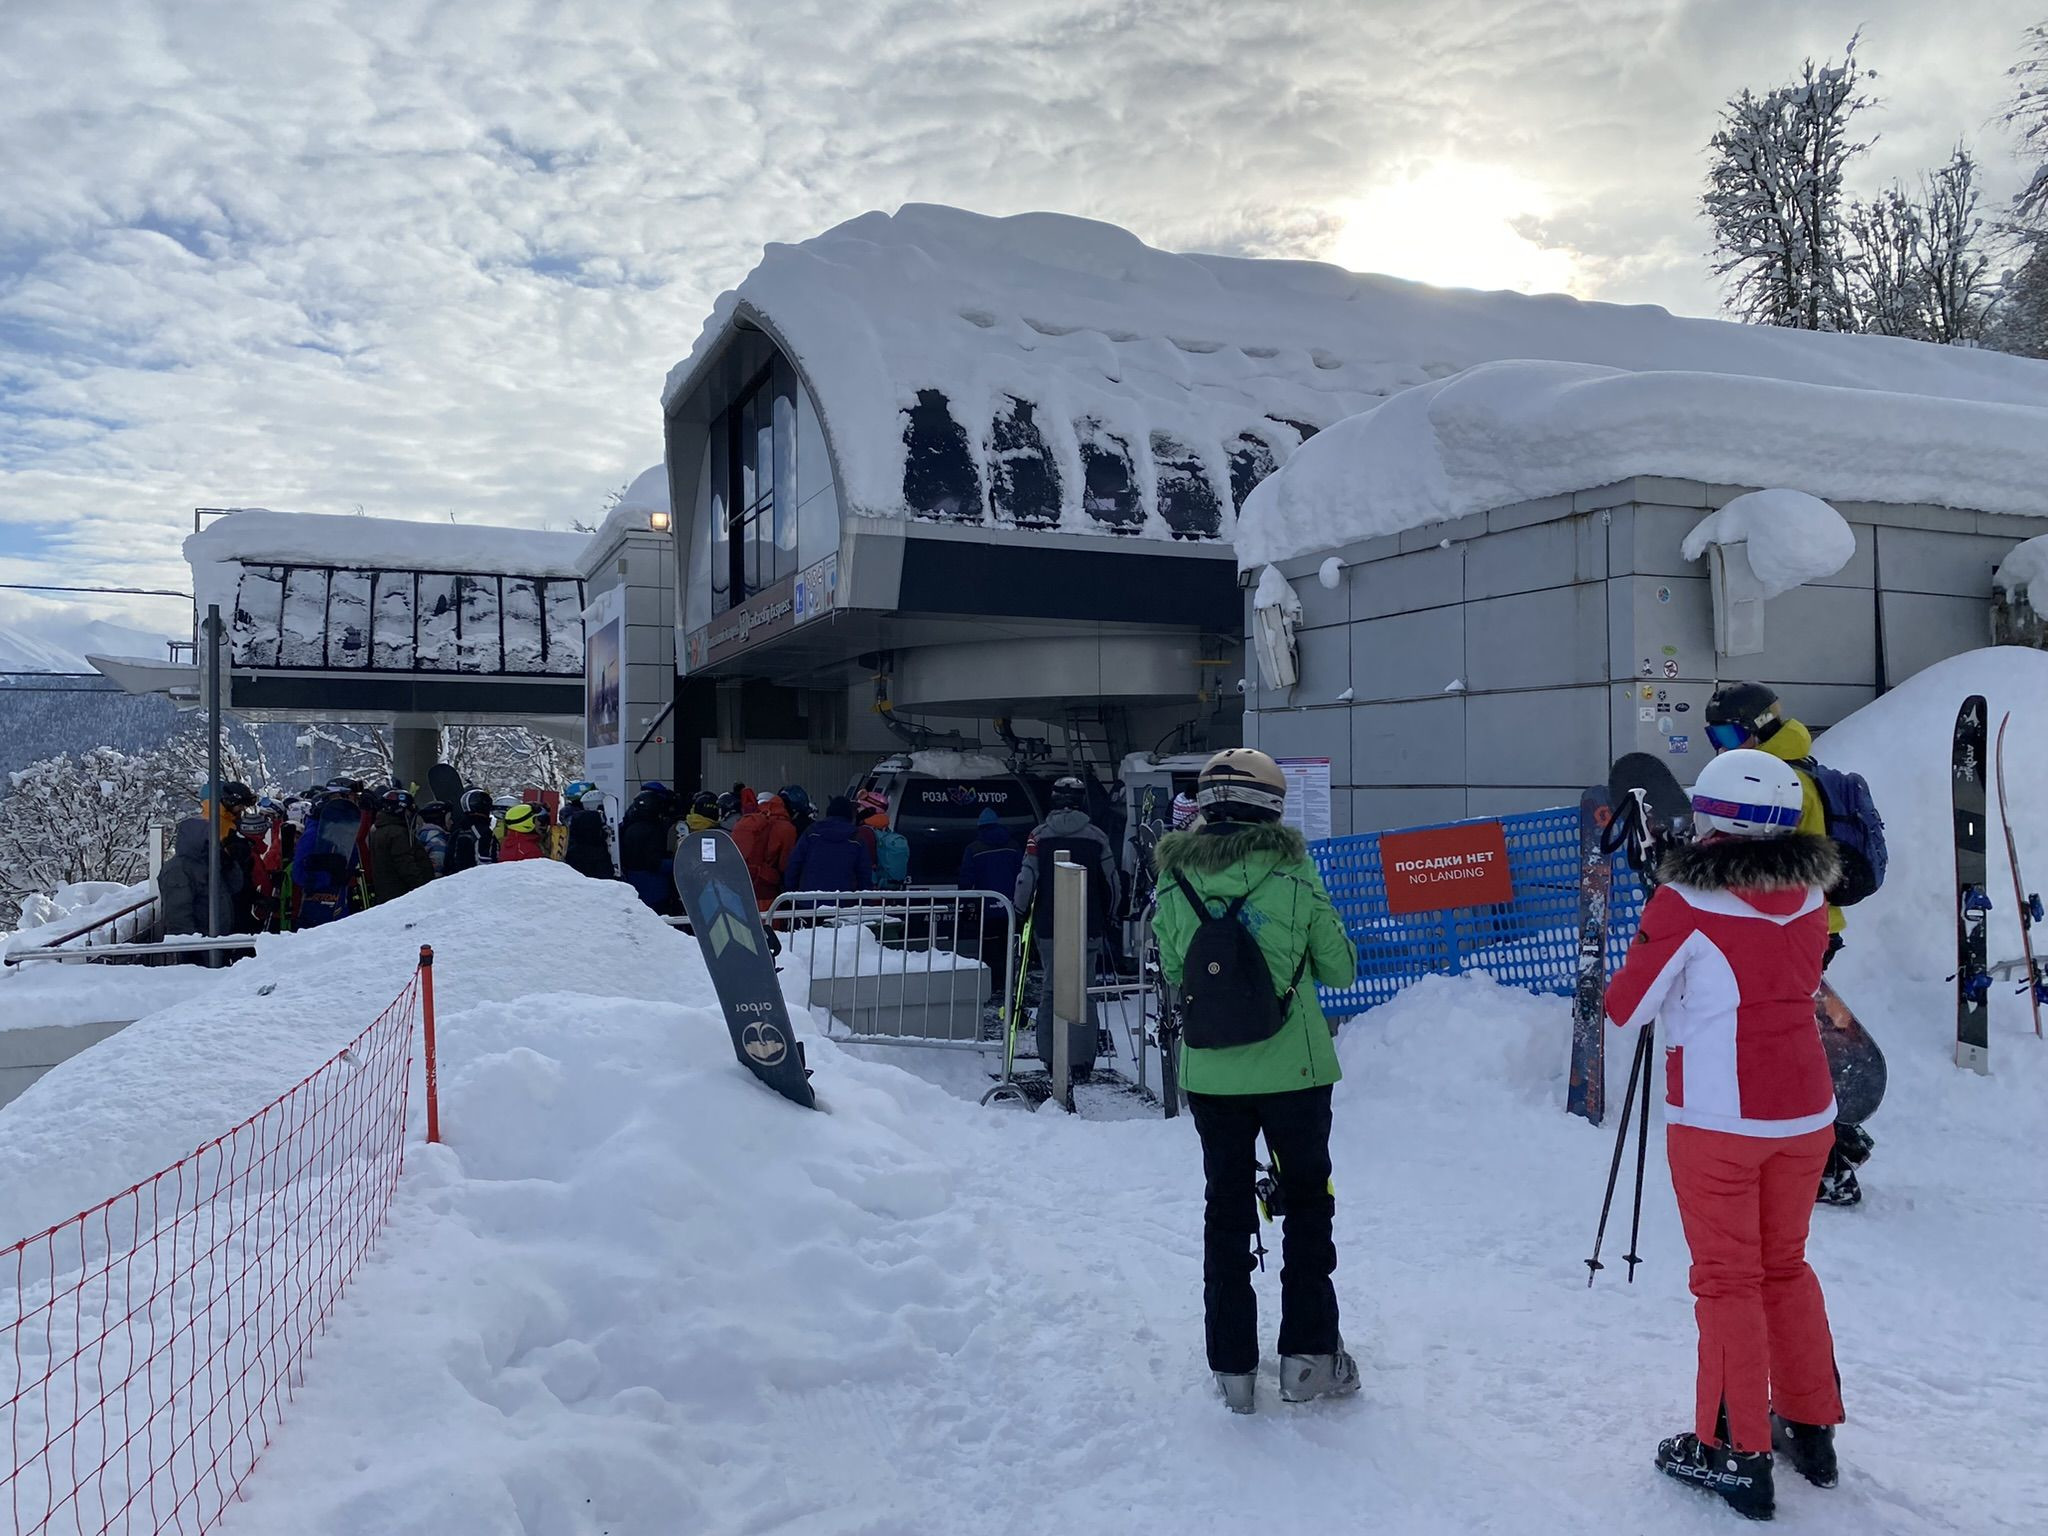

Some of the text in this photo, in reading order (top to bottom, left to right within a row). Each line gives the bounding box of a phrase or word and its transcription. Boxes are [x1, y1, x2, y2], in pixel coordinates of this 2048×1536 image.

[1965, 744, 1975, 782] ATOMIC
[922, 791, 1008, 803] РОЗА ХУТОР
[1395, 851, 1495, 872] ПОСАДКИ НЕТ
[1409, 867, 1485, 884] NO LANDING
[735, 1002, 772, 1017] arbor
[1666, 1461, 1753, 1489] FISCHER
